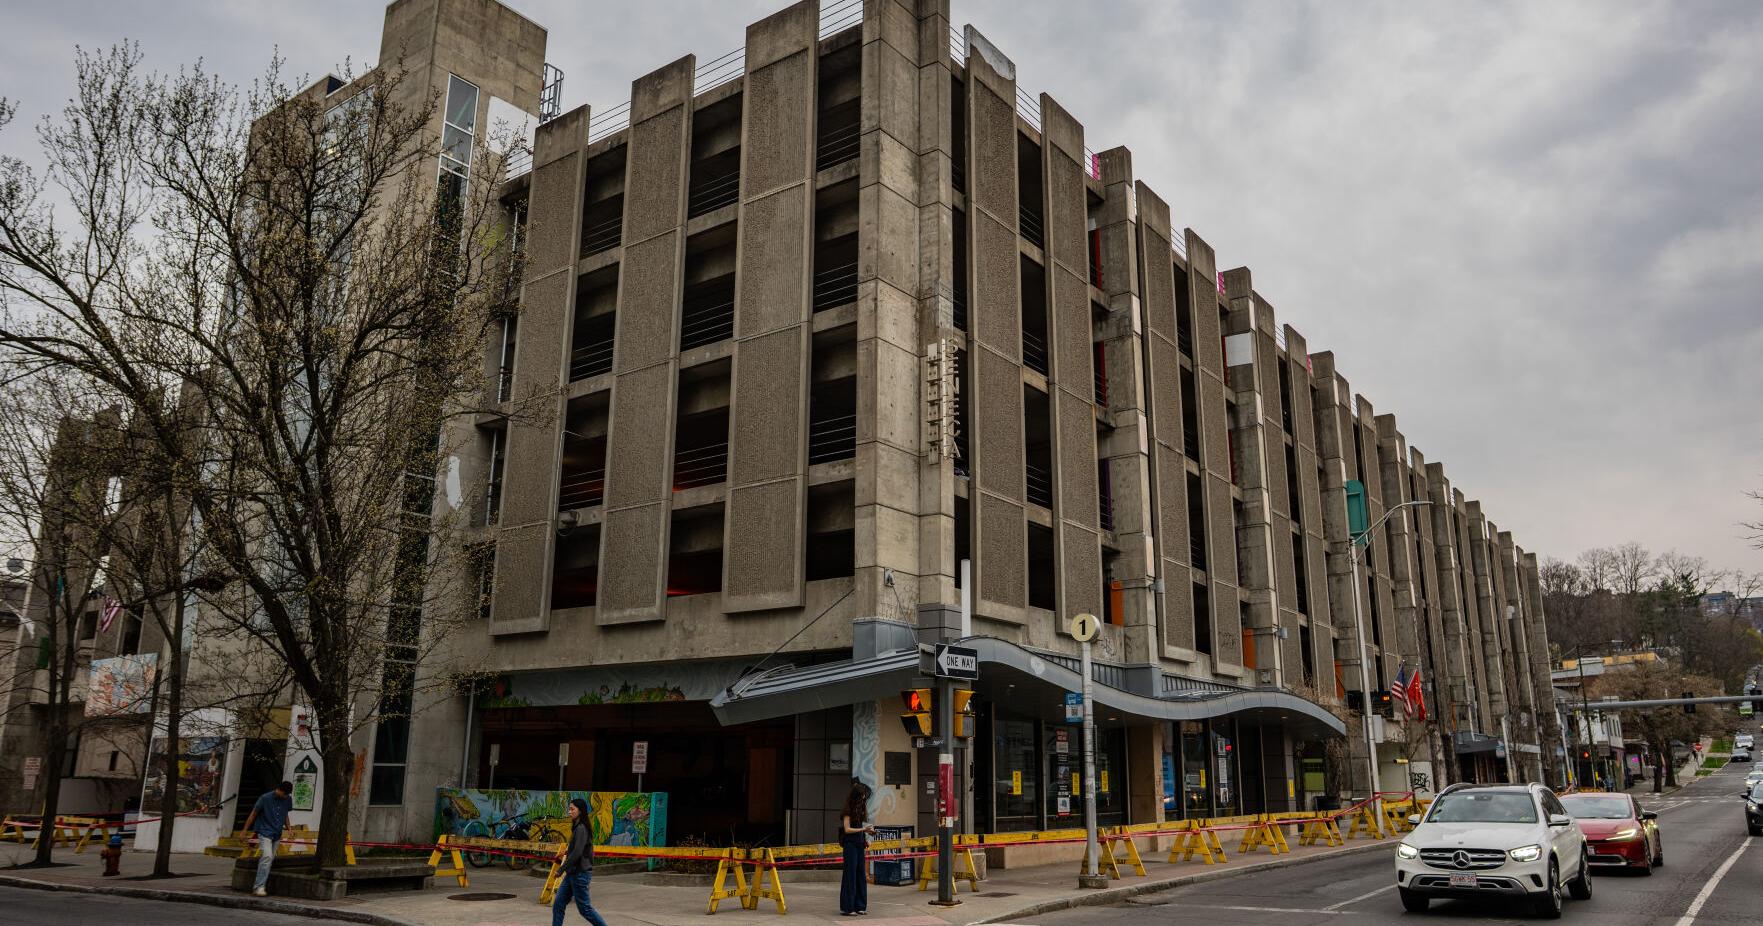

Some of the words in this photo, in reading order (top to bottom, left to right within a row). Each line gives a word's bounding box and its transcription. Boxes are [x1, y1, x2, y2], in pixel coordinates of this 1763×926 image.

[945, 337, 961, 459] SENECA
[1079, 619, 1086, 636] 1
[946, 655, 958, 667] ONE
[961, 656, 975, 669] WAY
